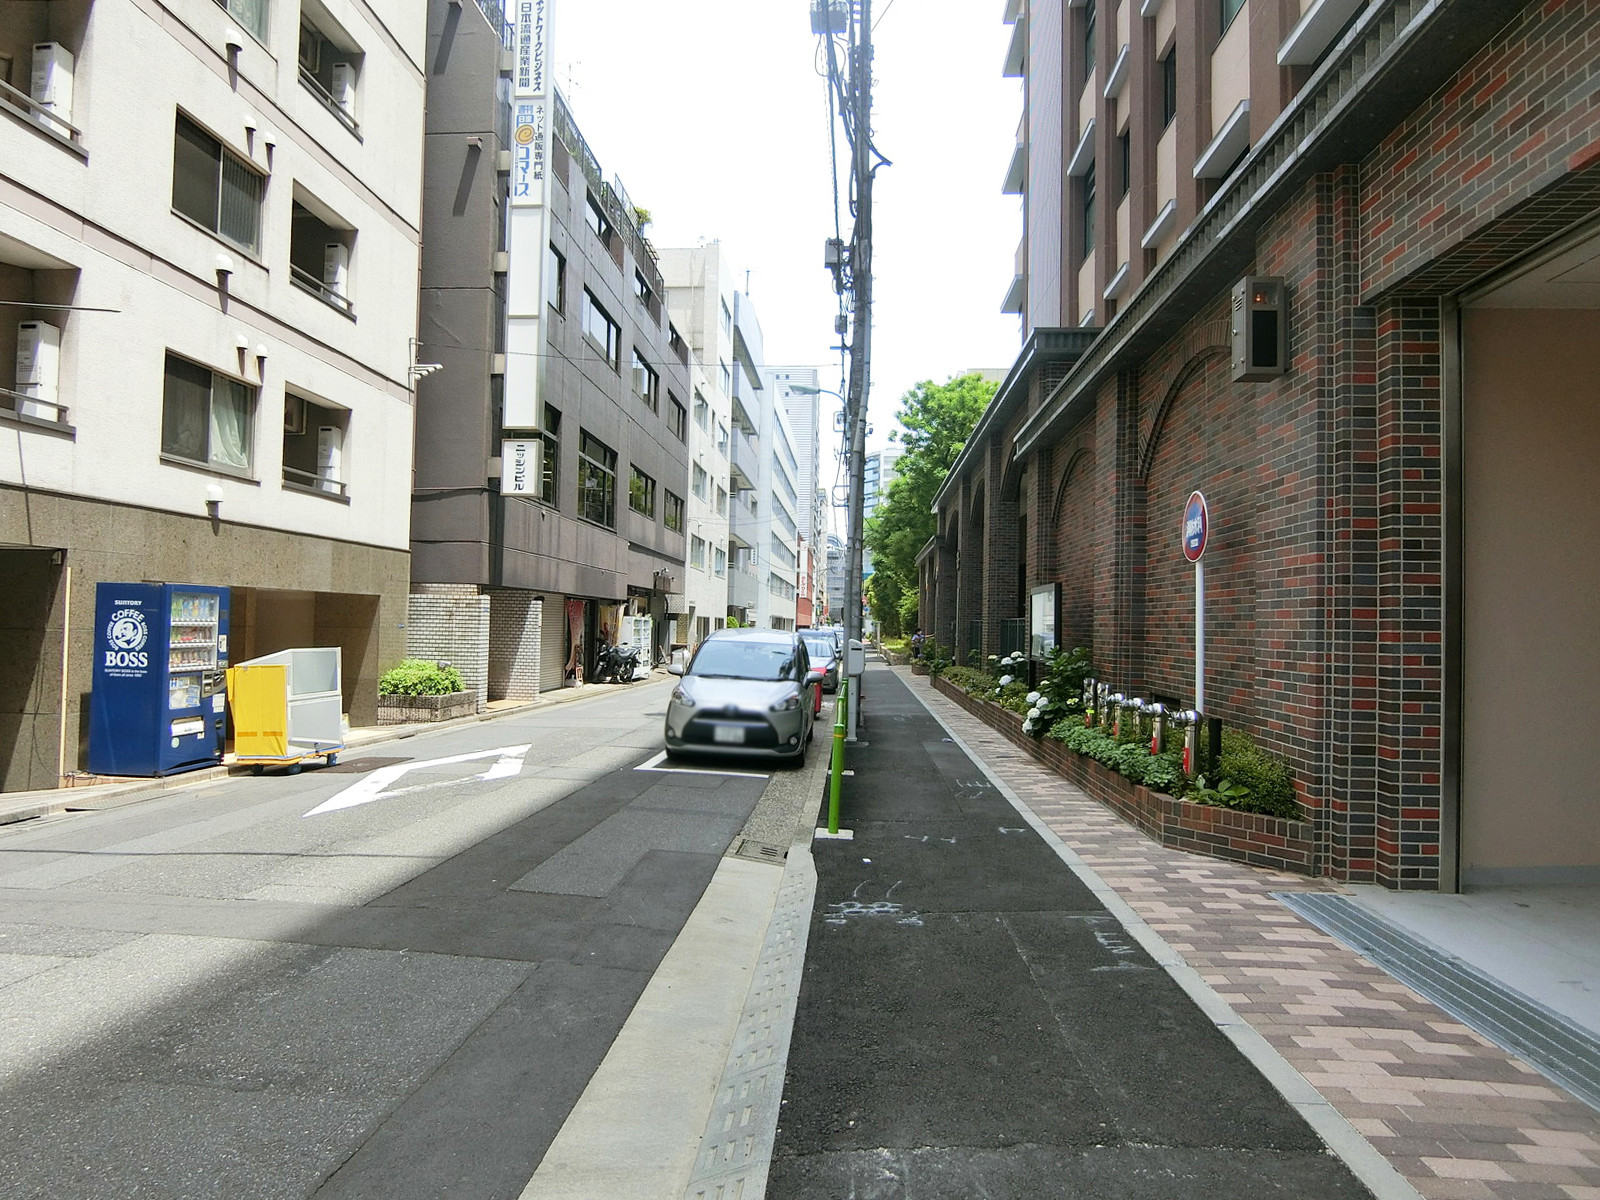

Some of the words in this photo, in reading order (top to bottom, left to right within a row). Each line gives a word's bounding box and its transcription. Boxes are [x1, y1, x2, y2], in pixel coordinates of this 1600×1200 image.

[519, 2, 531, 88] 日本流通産業新聞
[533, 105, 544, 180] ネット通販専門紙
[513, 444, 526, 491] ニッシンビル
[111, 608, 145, 622] COFFEE
[105, 651, 148, 667] BOSS
